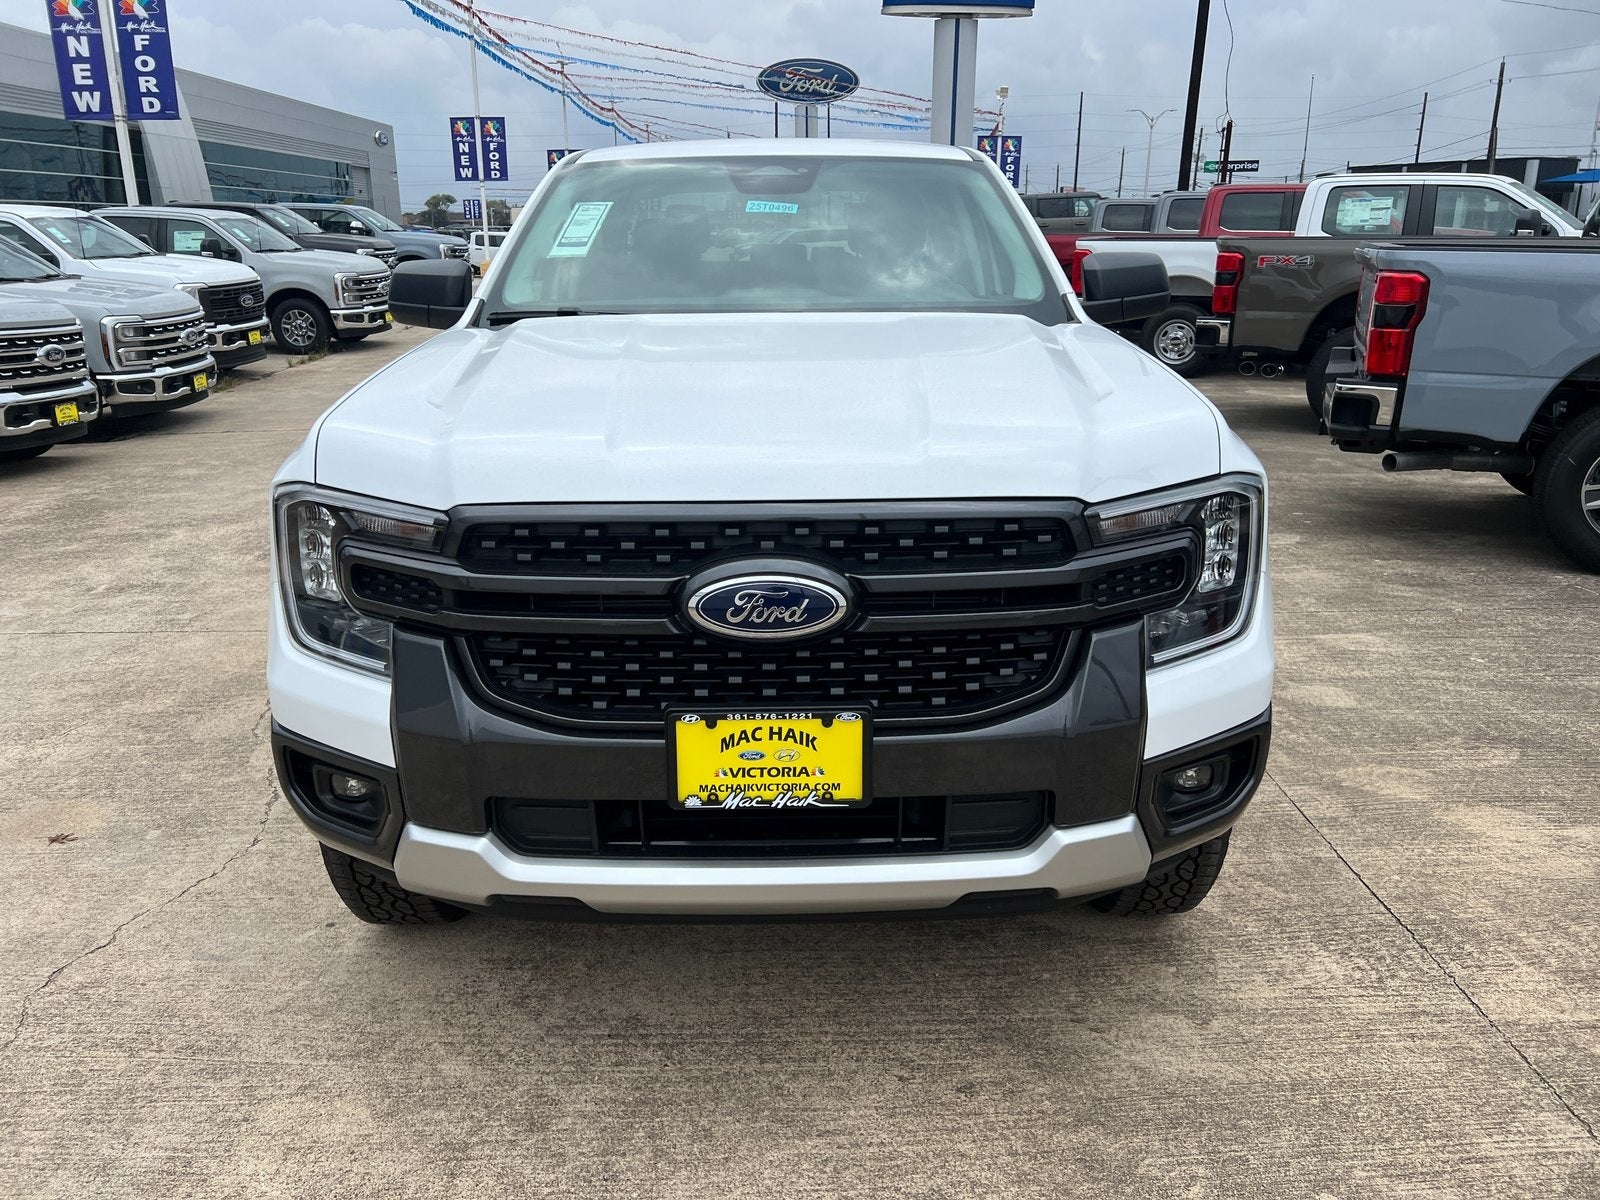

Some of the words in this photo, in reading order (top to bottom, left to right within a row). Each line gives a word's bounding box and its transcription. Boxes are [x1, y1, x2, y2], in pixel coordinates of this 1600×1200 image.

[66, 35, 101, 113] NEW
[133, 34, 161, 113] FORD
[779, 66, 839, 93] Ford
[458, 142, 473, 178] NEW
[488, 142, 501, 179] FORD
[1207, 161, 1259, 171] enerprise
[748, 201, 795, 212] 25T0496
[1257, 254, 1315, 269] FX4
[726, 589, 810, 624] Ford
[719, 726, 763, 753] MAC
[768, 726, 819, 752] HAIK
[728, 766, 811, 779] VICTORIA
[698, 782, 841, 793] MACHAIKVICTORIA.COM
[720, 790, 764, 810] Mac
[771, 790, 821, 809] Haik
